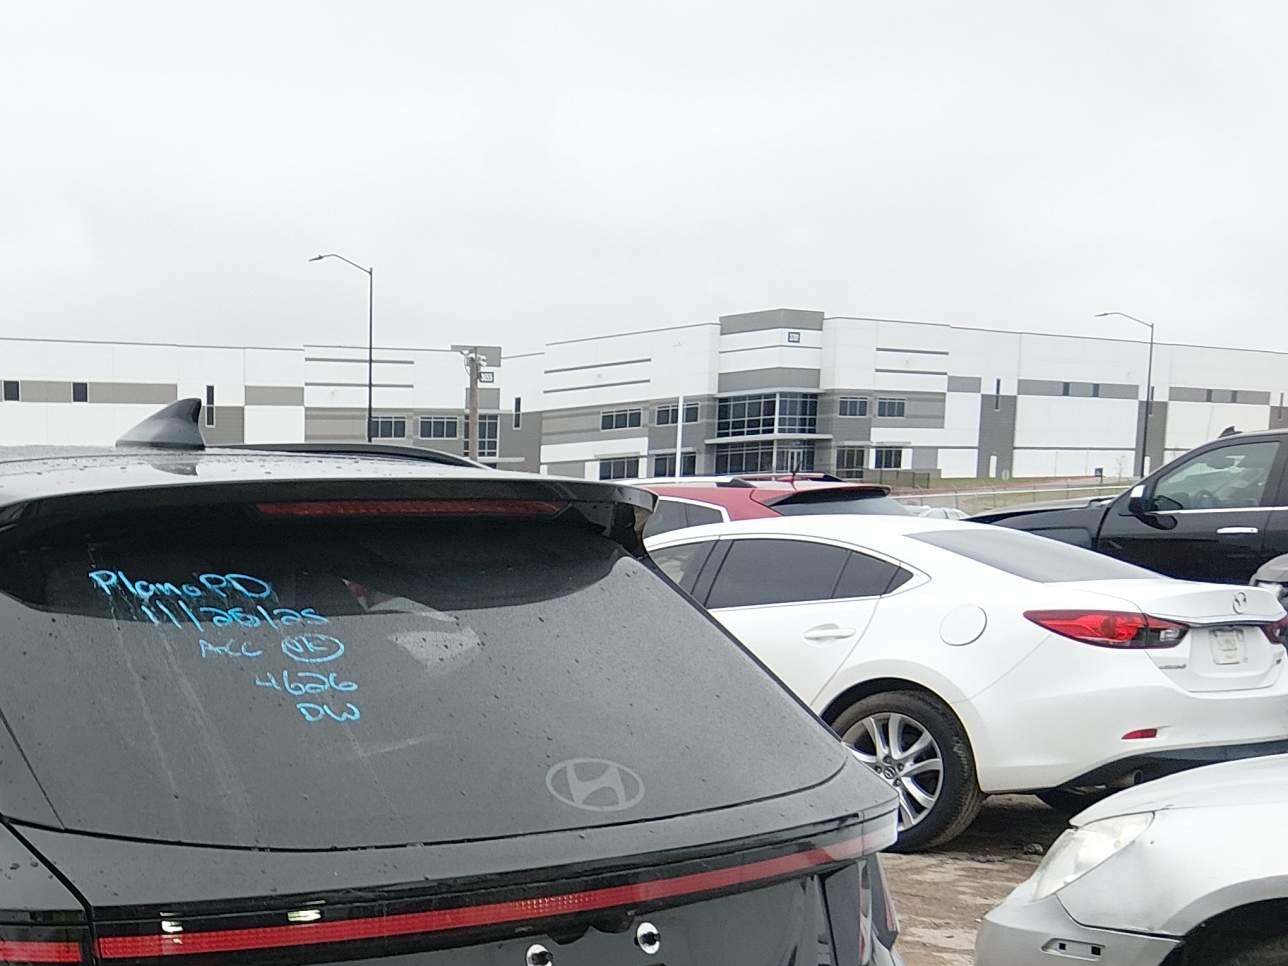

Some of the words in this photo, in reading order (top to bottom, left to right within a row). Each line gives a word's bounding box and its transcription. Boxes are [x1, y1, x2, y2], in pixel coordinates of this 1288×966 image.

[89, 570, 201, 599] Plano
[199, 573, 273, 599] PD
[255, 669, 359, 696] 4626
[296, 702, 361, 722] DW
